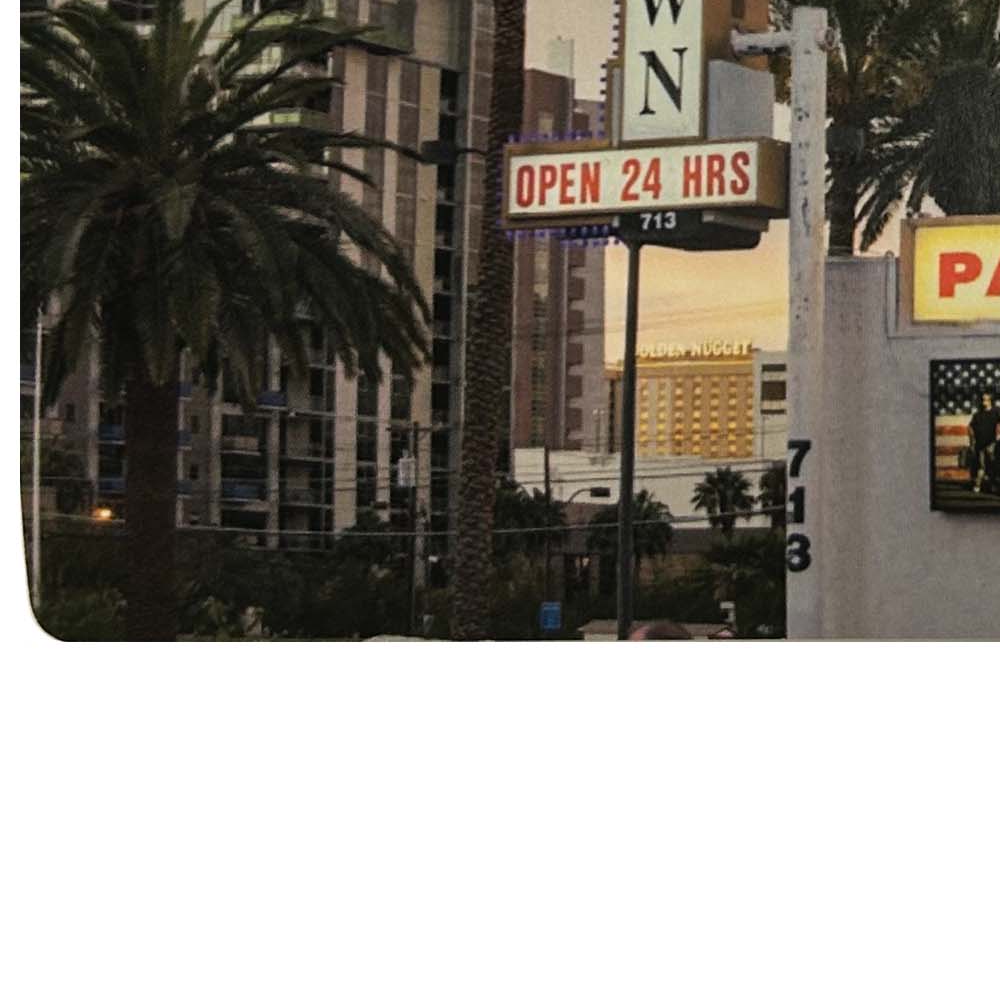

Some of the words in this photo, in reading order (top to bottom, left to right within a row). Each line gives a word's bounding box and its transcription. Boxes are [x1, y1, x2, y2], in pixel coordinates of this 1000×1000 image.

[516, 161, 601, 208] OPEN
[620, 157, 663, 202] 24
[682, 151, 751, 199] HRS
[640, 211, 677, 230] 713
[787, 439, 812, 573] 713
